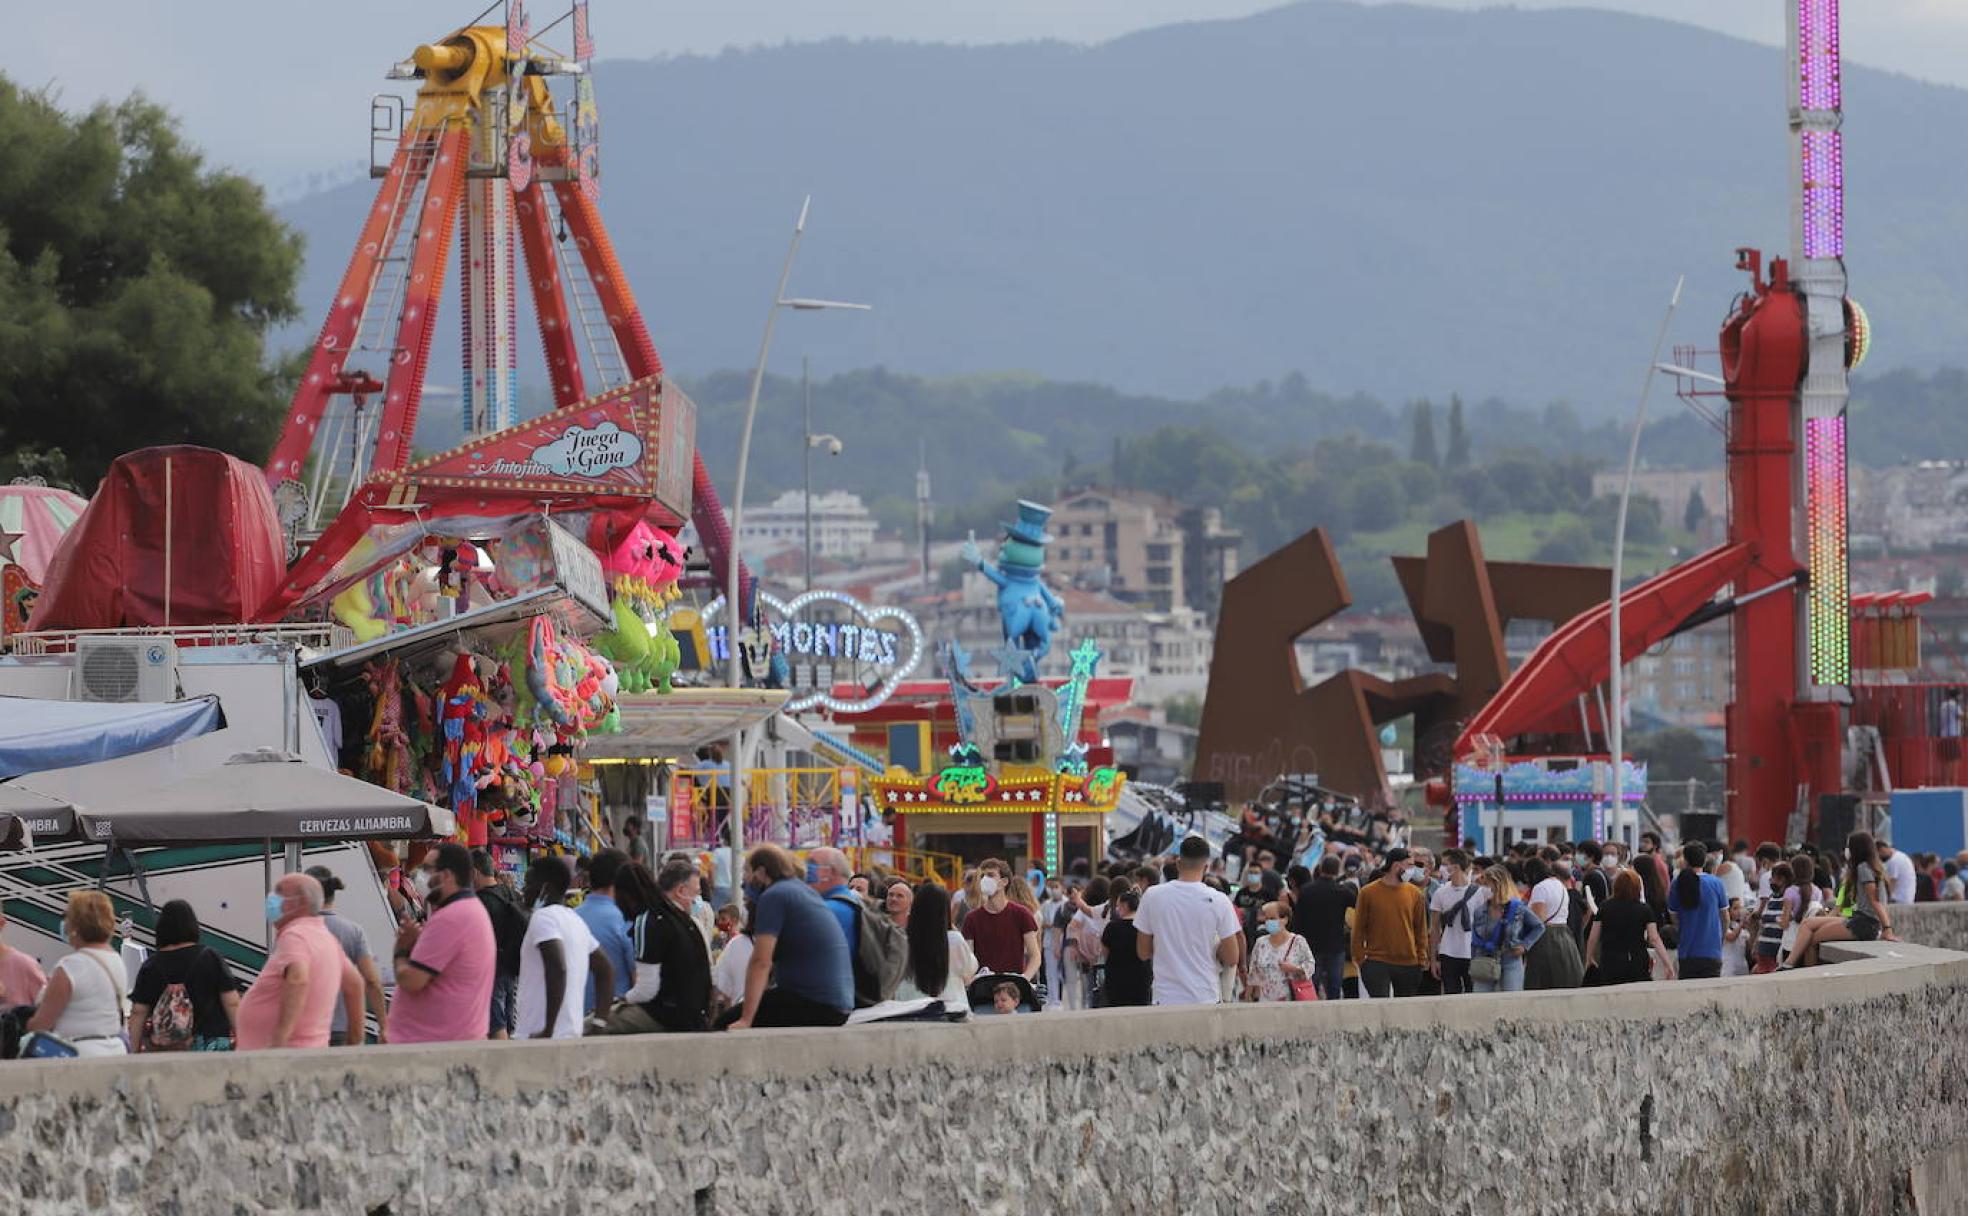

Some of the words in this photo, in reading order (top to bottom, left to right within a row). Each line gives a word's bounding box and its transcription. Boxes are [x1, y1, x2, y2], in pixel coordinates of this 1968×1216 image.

[567, 431, 619, 453] Juega
[477, 458, 550, 479] Antojitos
[565, 451, 575, 474] y
[578, 450, 624, 472] Gana
[770, 622, 896, 665] MONTES
[300, 819, 350, 832] CERVEZAS
[354, 817, 412, 830] ALHAMBRA
